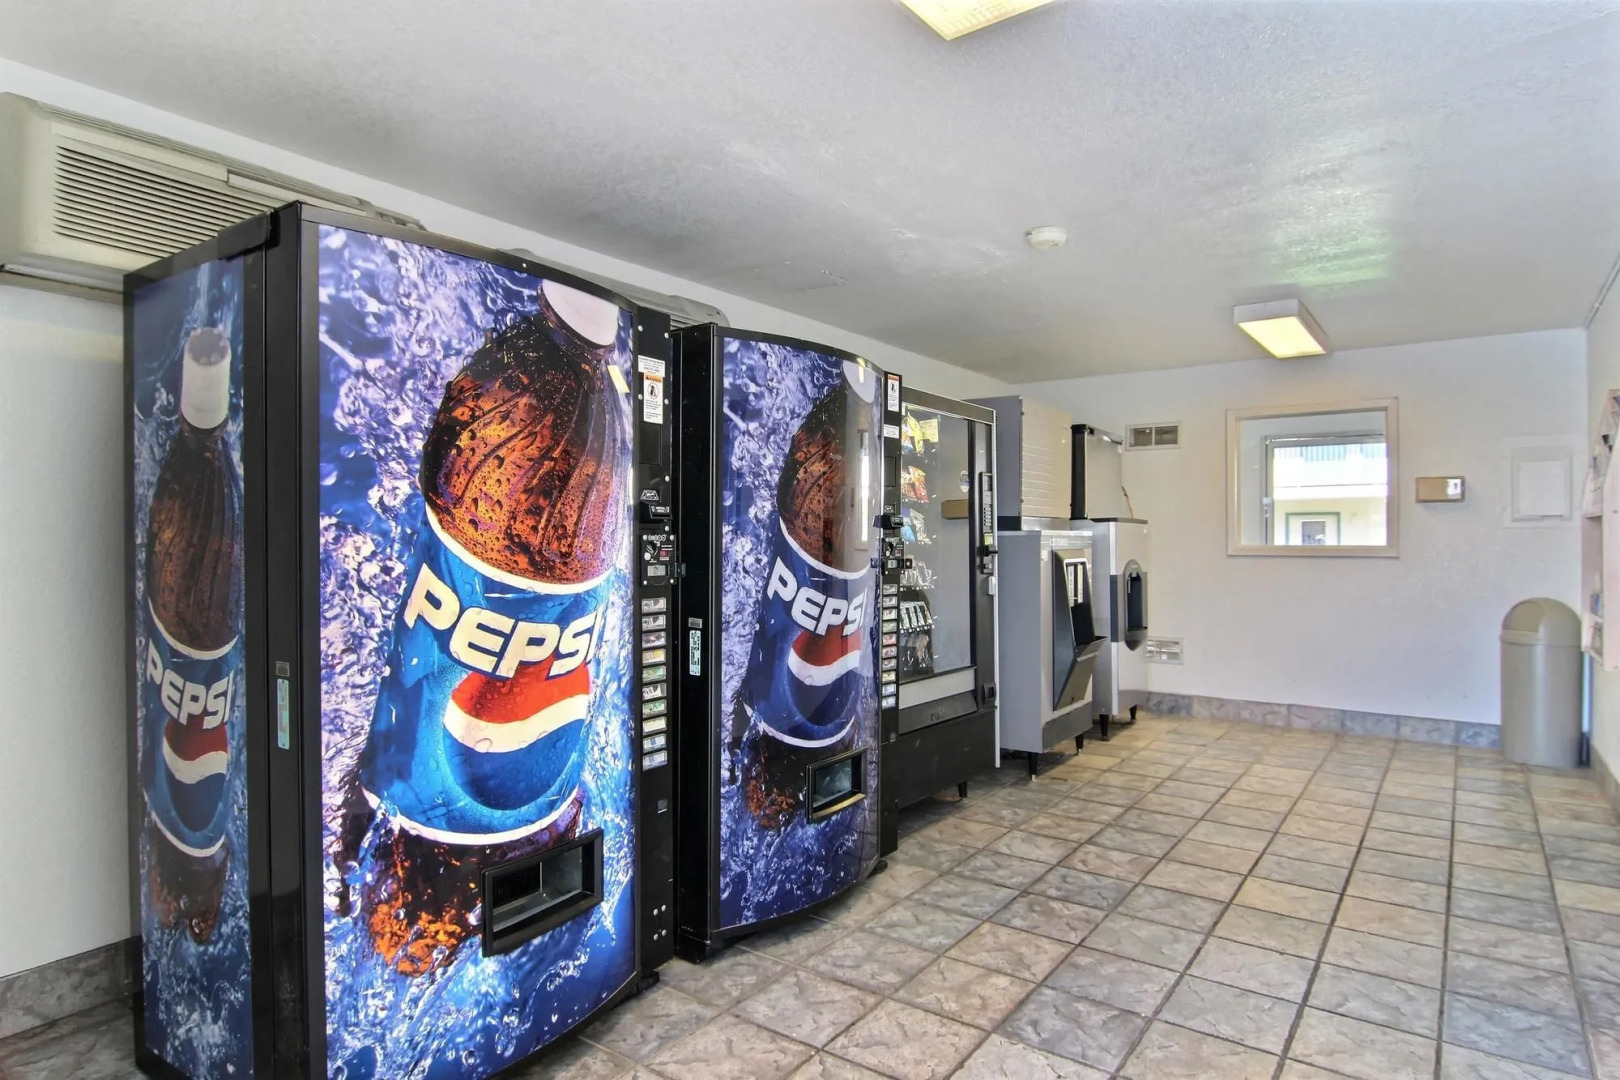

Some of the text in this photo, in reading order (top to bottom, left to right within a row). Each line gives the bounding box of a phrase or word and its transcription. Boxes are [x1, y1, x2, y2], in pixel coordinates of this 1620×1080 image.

[404, 562, 598, 679] PEPSI
[766, 555, 868, 636] PEPSI
[146, 637, 234, 729] PEPSI
